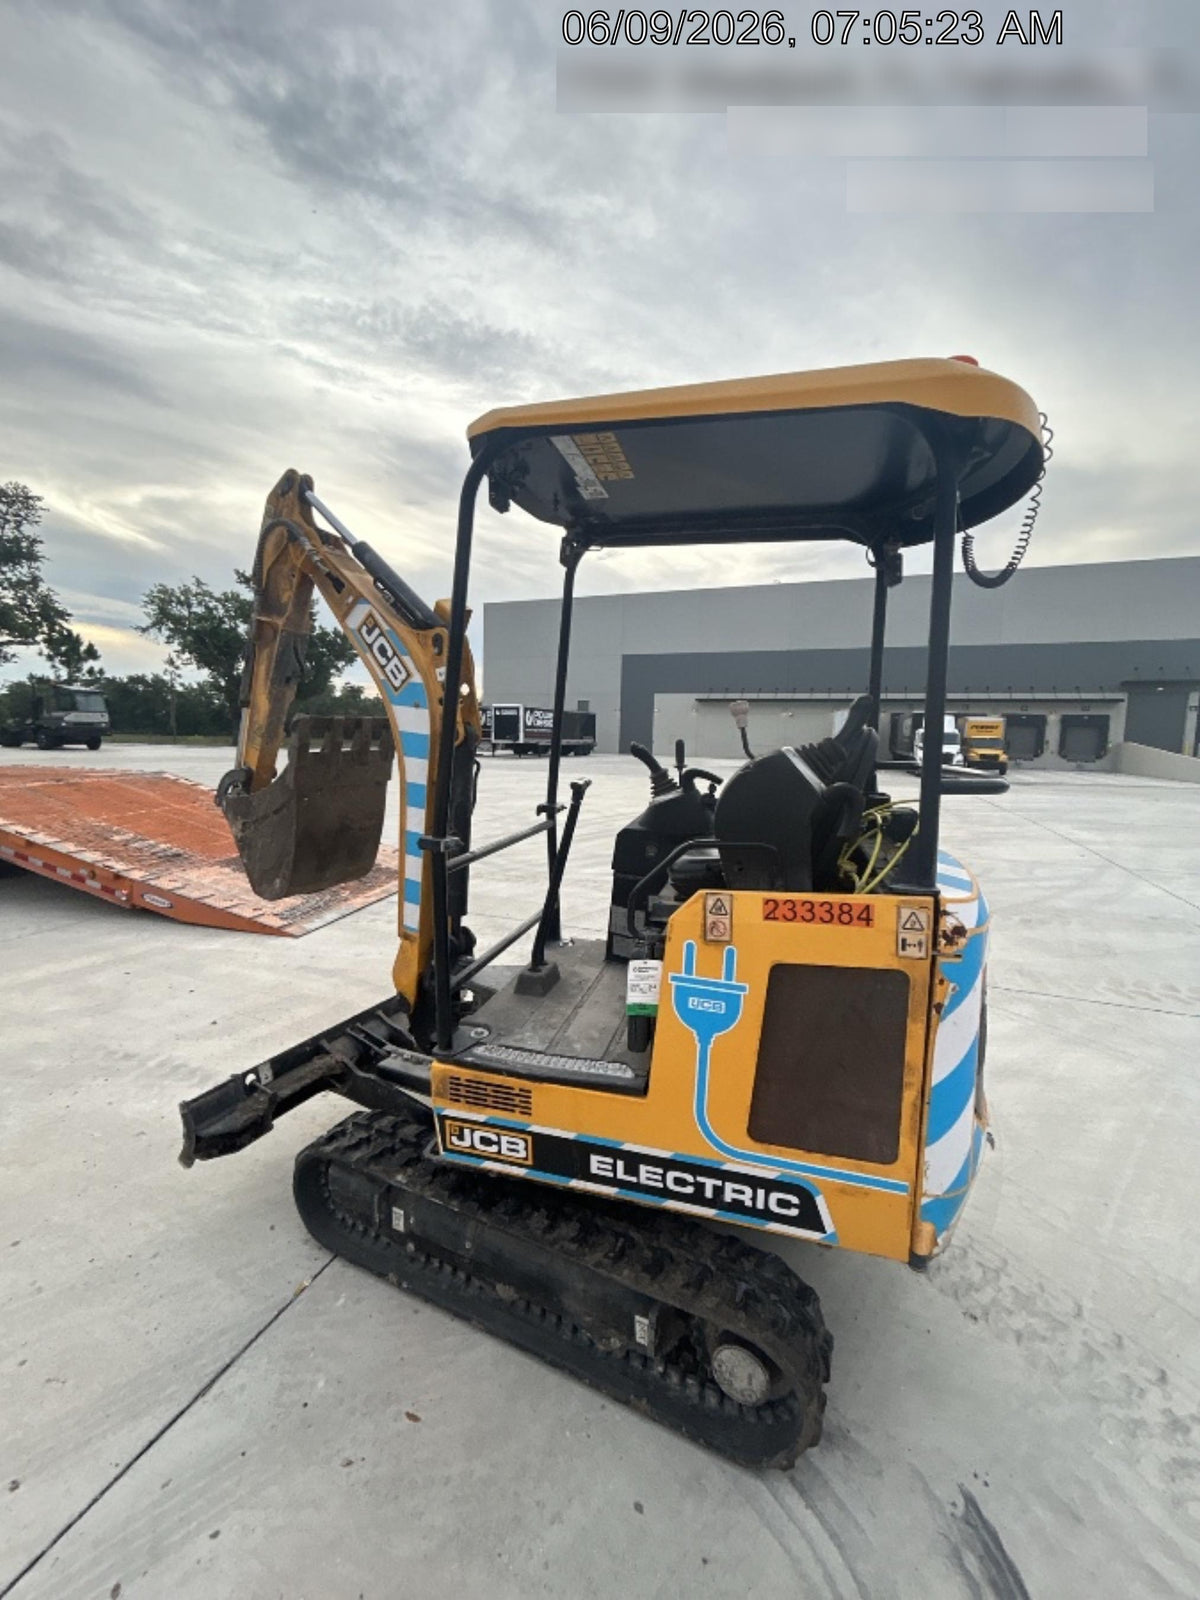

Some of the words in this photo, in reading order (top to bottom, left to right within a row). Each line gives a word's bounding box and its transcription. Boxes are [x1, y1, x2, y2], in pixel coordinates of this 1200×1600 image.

[360, 622, 409, 688] JCB
[763, 898, 874, 927] 233384
[690, 998, 725, 1013] JCB
[449, 1125, 529, 1160] JCB
[588, 1154, 801, 1218] ELECTRIC
